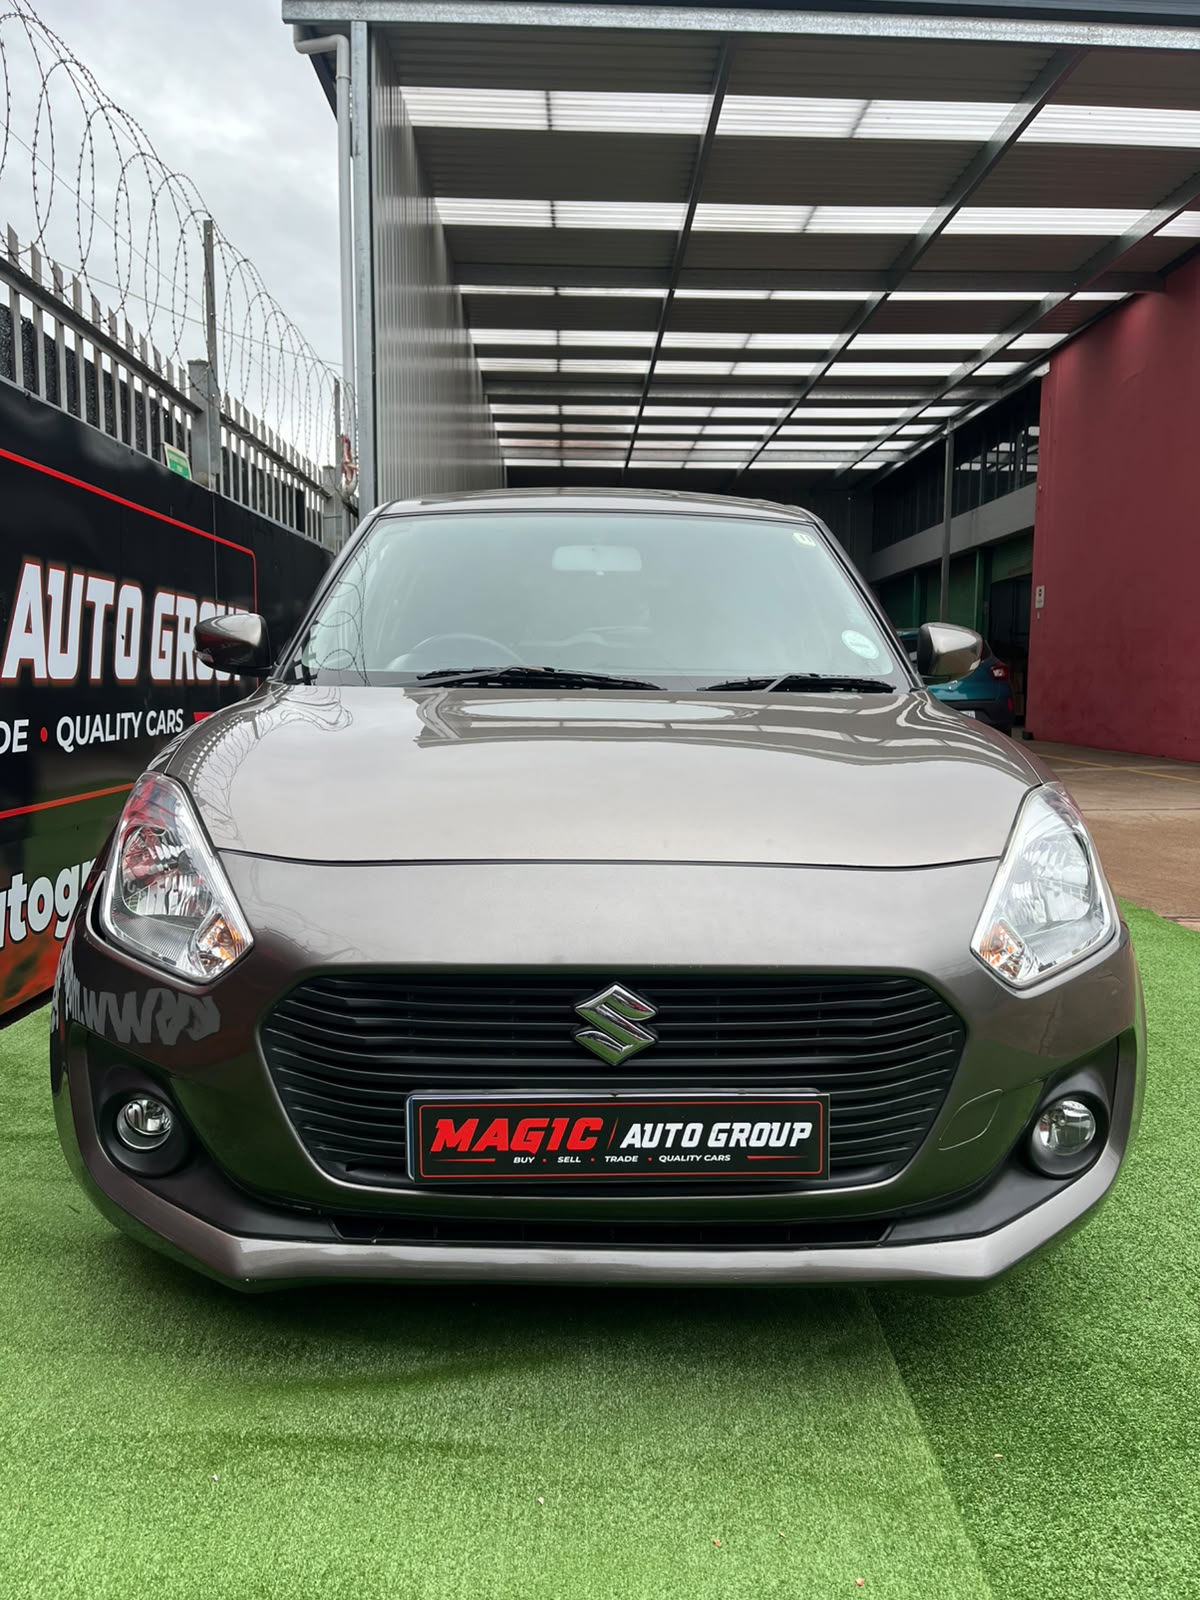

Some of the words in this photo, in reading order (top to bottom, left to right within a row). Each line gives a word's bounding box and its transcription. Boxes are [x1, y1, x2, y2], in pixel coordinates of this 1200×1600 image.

[1, 562, 143, 680] AUTO
[56, 711, 143, 753] QUALITY
[145, 708, 184, 737] CARS
[619, 1122, 704, 1148] AUTO
[707, 1121, 813, 1148] GROUP
[513, 1156, 535, 1164] BUY
[604, 1155, 639, 1163] TRADE
[658, 1154, 702, 1163] QUALITY
[704, 1154, 731, 1162] CARS
